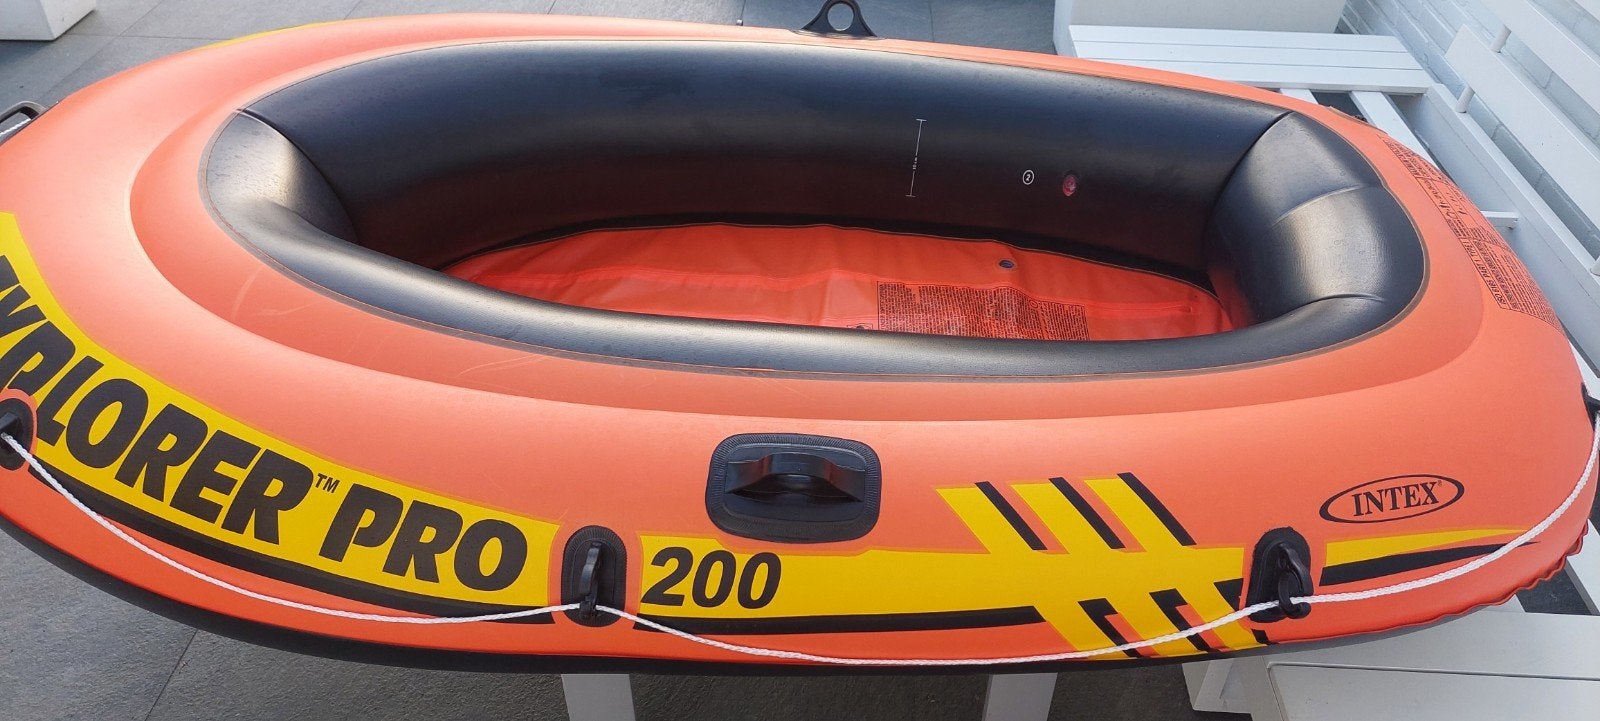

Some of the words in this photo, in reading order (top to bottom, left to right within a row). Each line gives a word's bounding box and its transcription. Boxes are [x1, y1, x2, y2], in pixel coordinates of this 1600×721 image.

[1353, 482, 1440, 517] INTEX
[319, 484, 528, 592] PRO
[641, 547, 782, 610] 200
